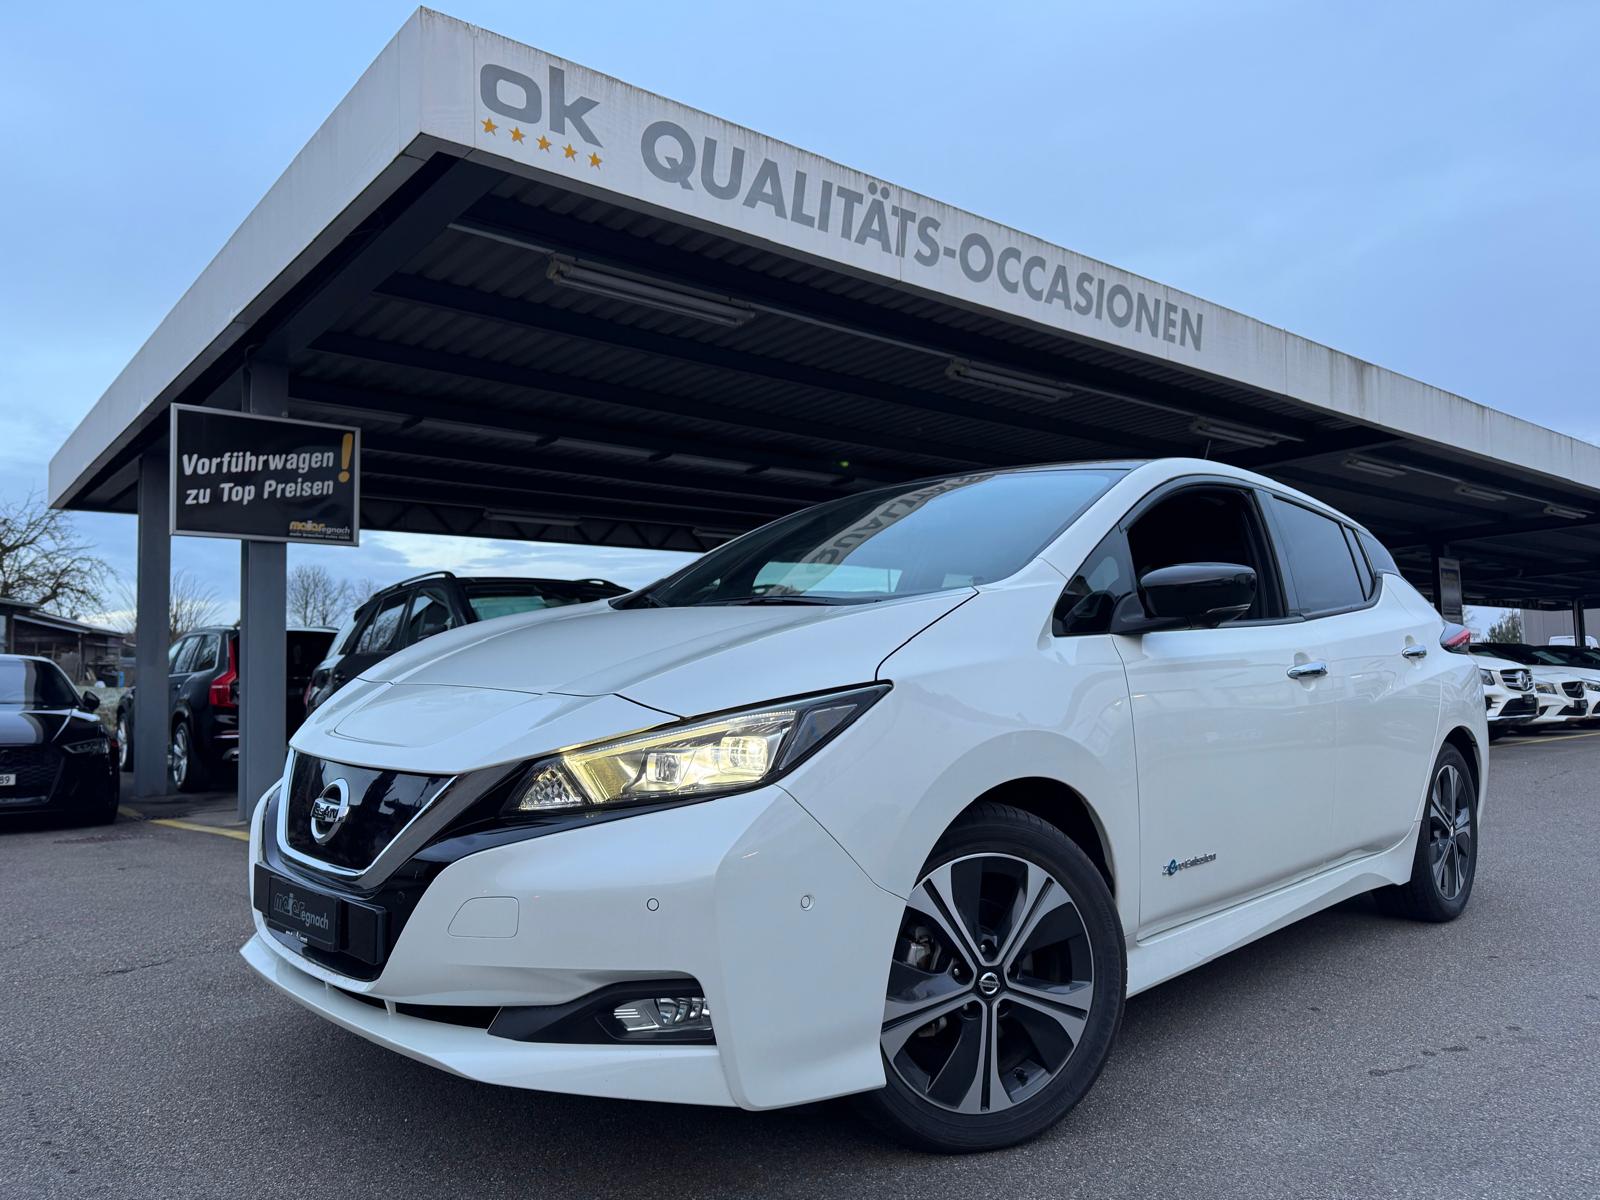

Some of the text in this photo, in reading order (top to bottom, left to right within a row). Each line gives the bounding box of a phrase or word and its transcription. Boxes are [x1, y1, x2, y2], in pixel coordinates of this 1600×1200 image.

[479, 63, 1204, 352] ok QUALITÄTS-OCCASIONEN
[182, 451, 335, 477] Vorführwagen
[185, 478, 334, 505] zu Top Preisen
